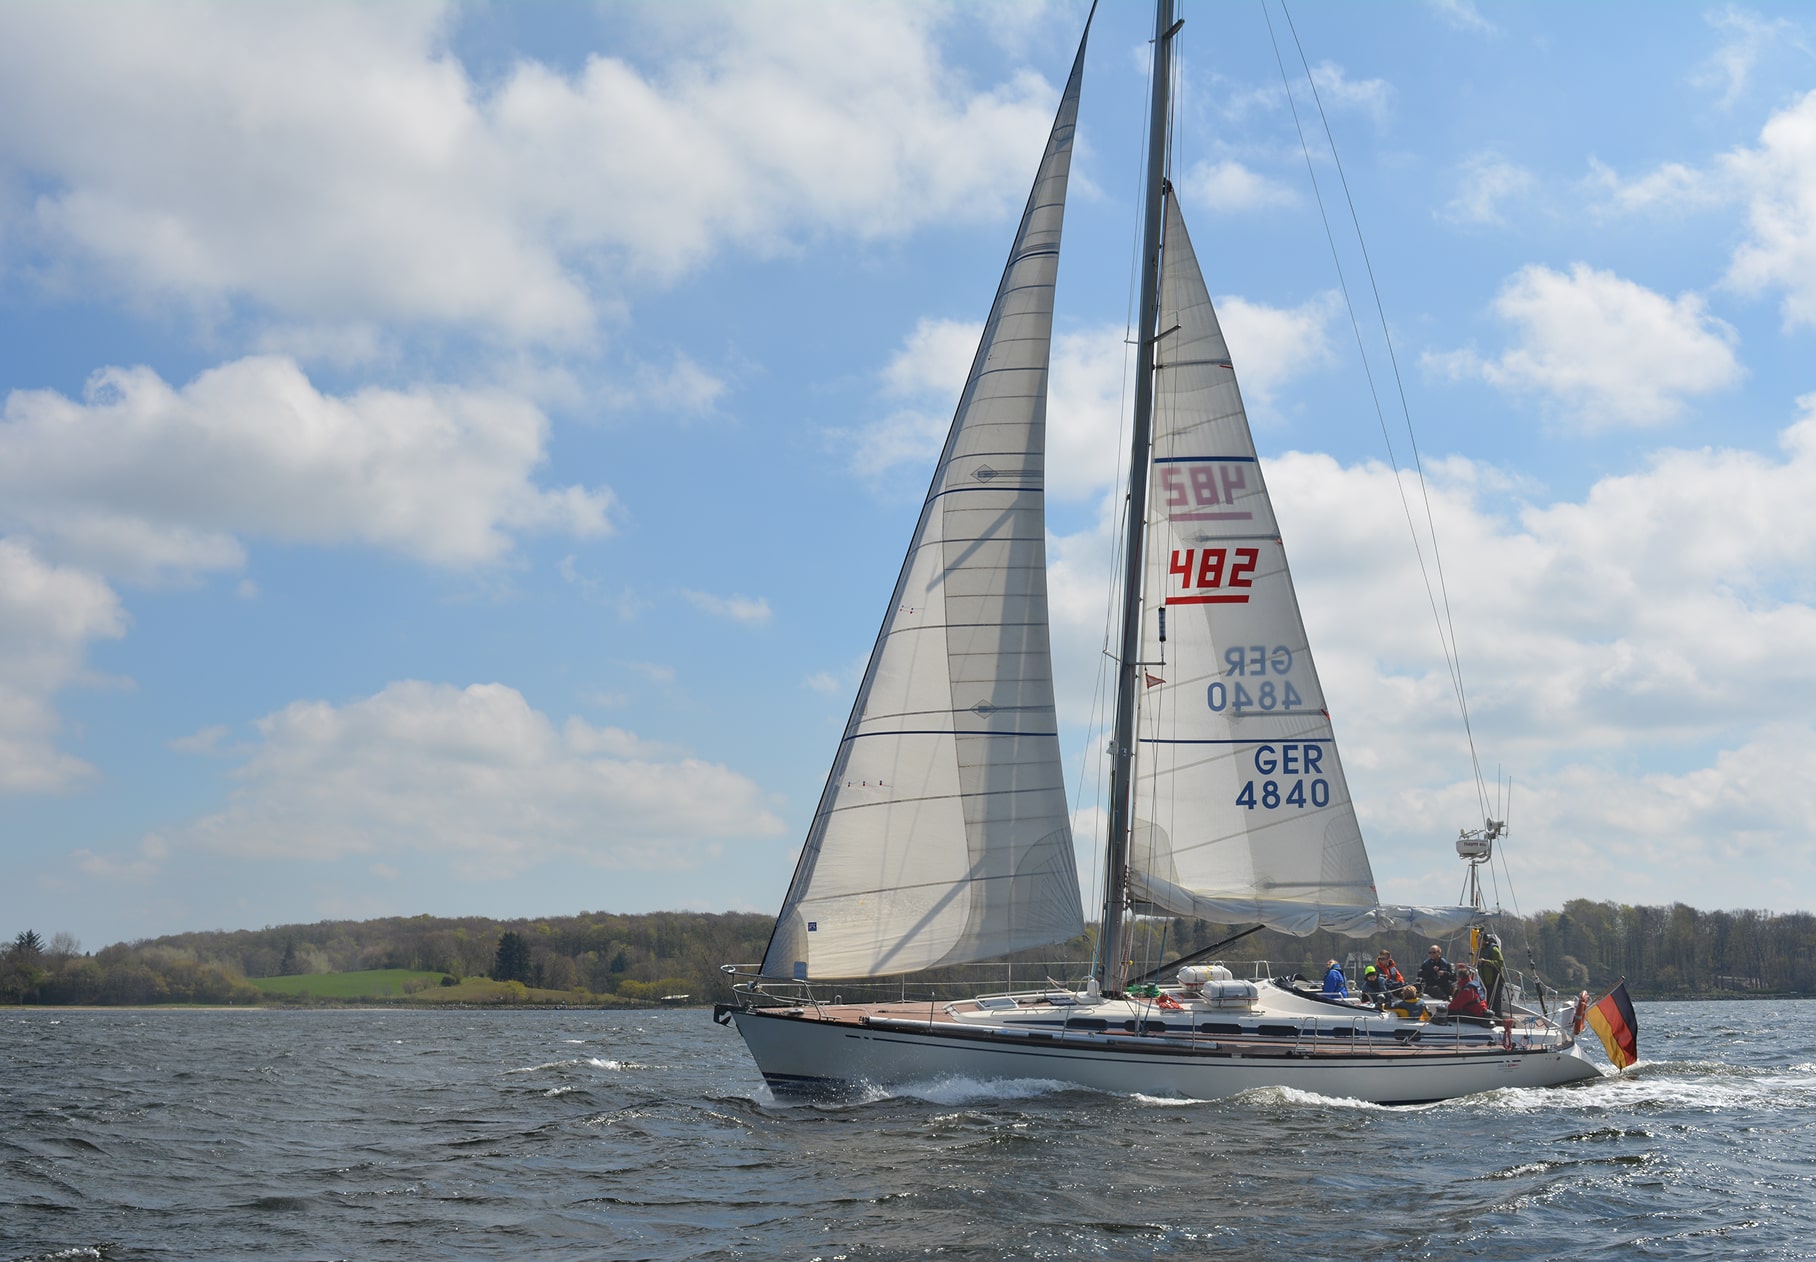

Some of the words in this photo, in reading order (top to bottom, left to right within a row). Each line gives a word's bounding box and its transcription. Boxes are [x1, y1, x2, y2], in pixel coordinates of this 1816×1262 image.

[1169, 548, 1259, 589] 482
[1255, 745, 1323, 775] GER
[1236, 779, 1330, 810] 4840
